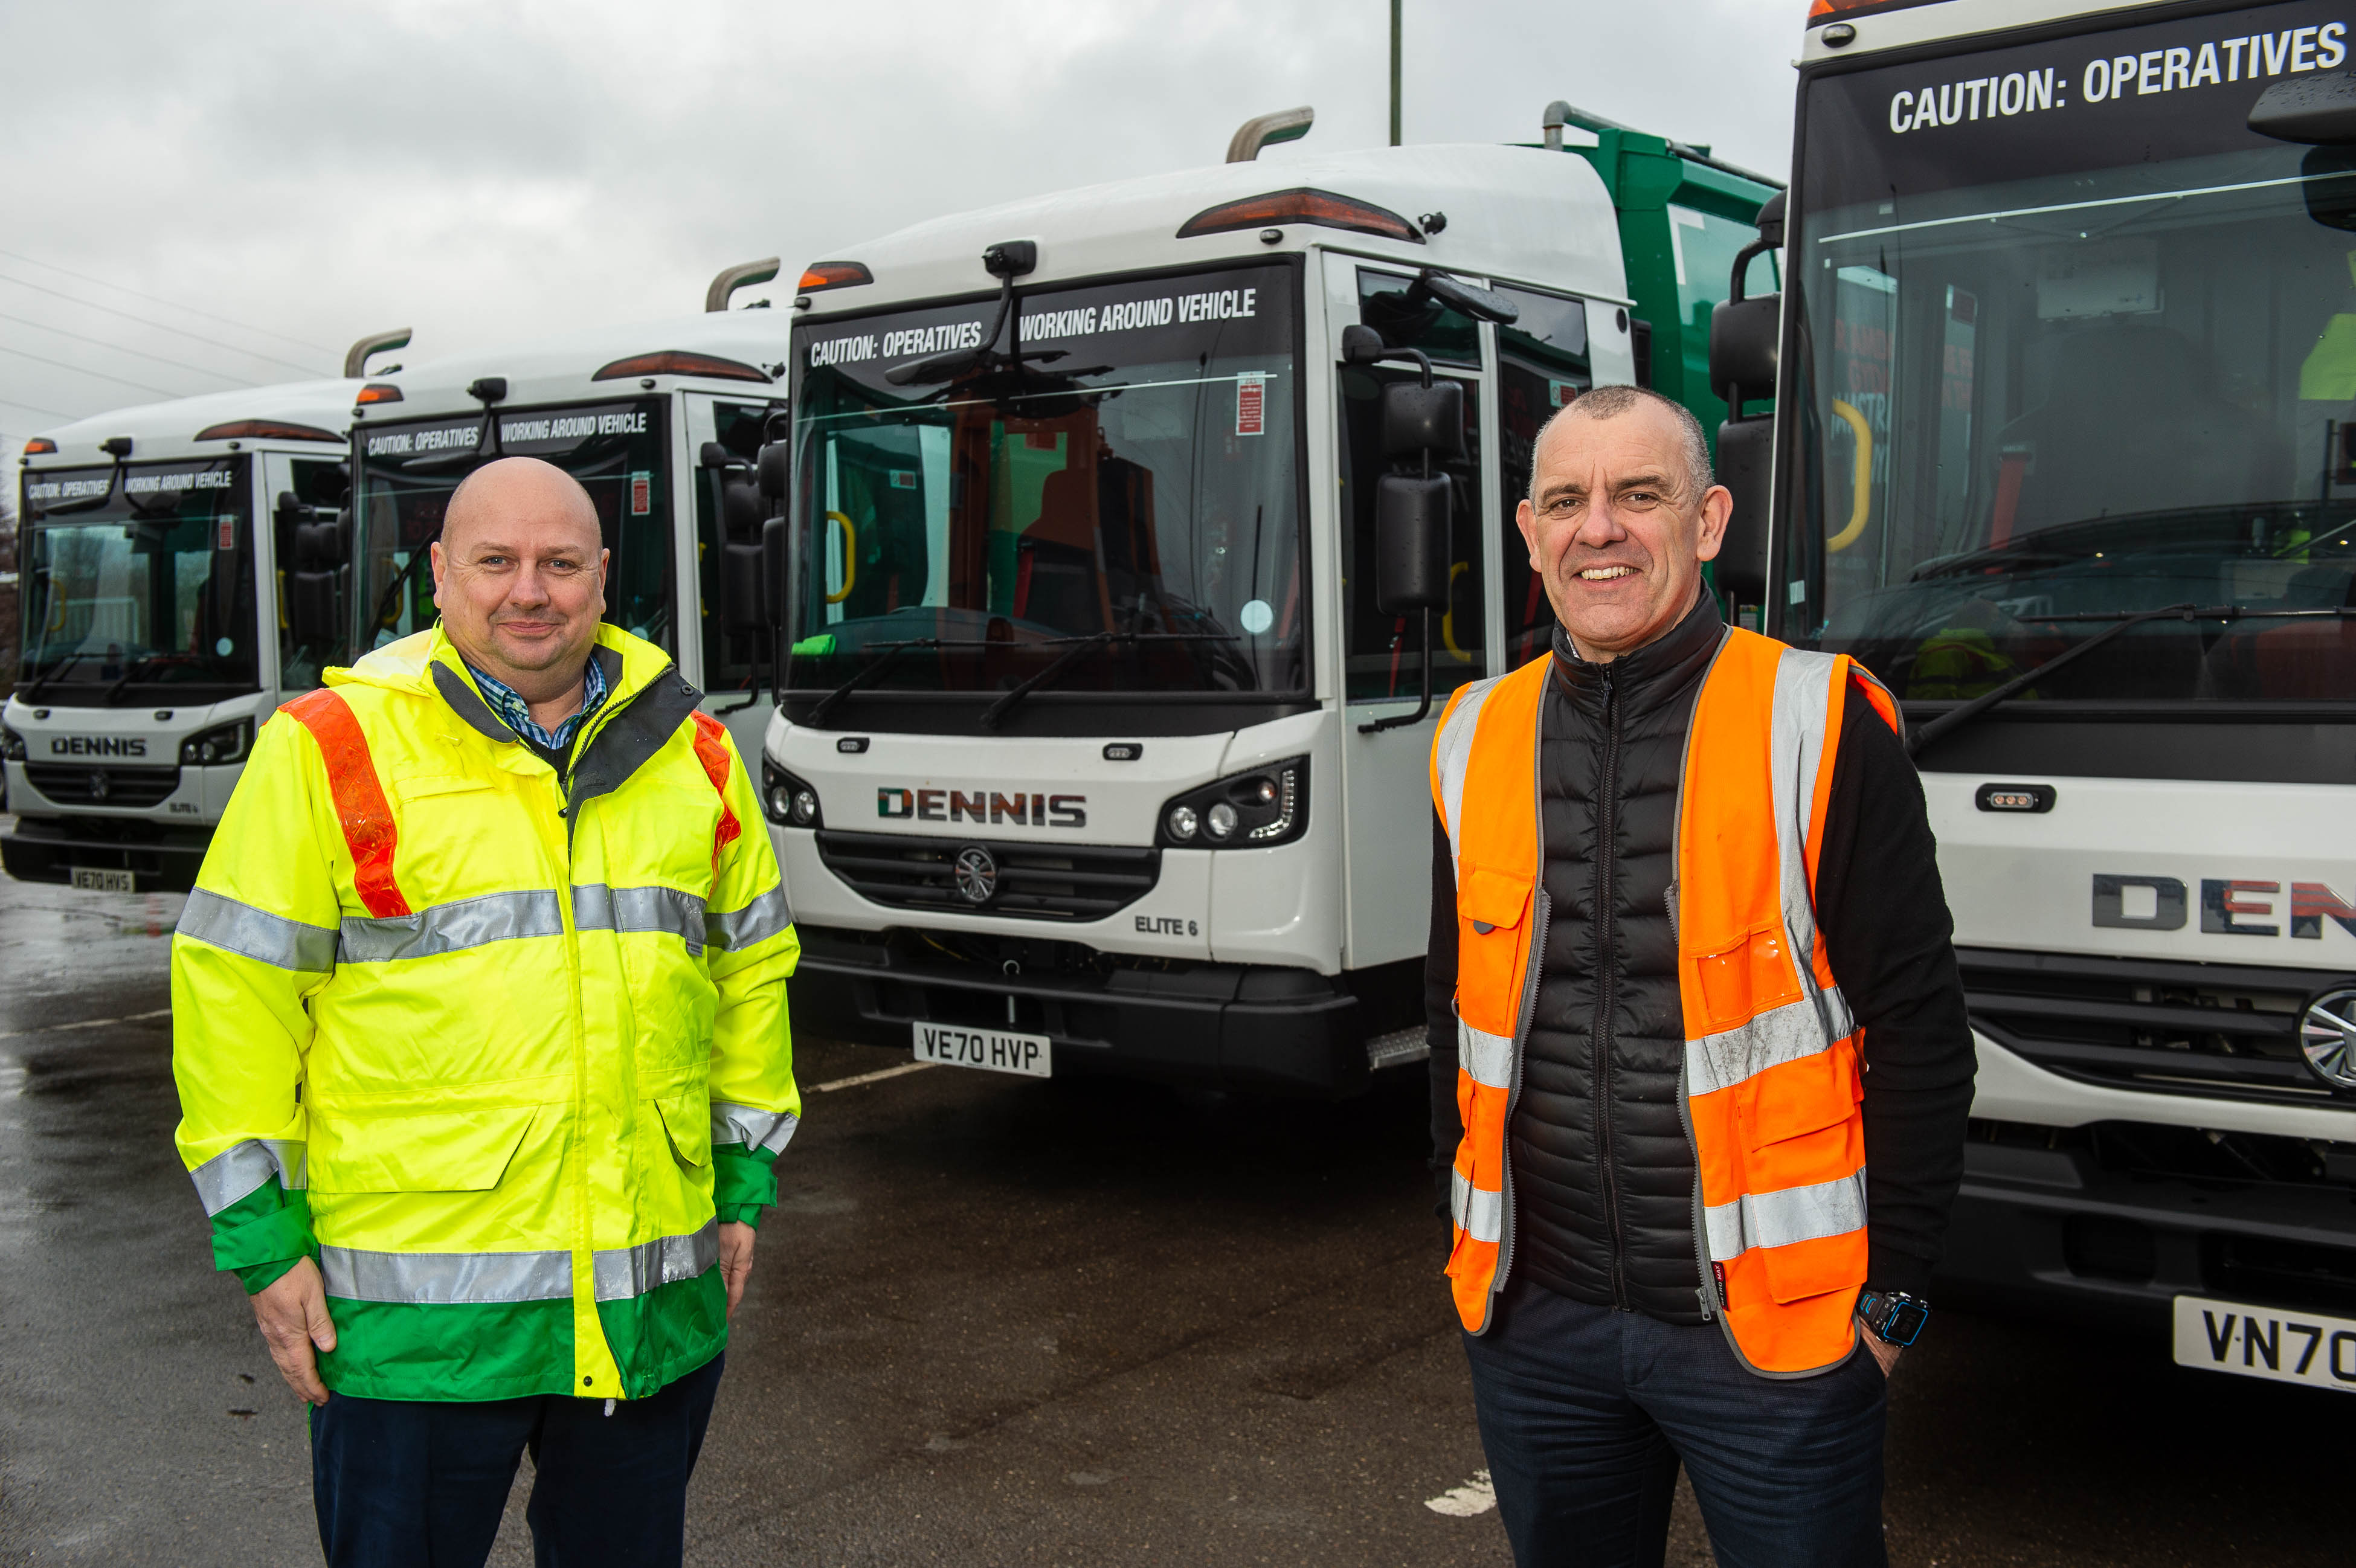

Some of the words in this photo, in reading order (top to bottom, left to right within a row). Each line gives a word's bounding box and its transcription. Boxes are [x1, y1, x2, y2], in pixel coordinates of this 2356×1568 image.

[1890, 67, 2067, 134] CAUTION:
[2083, 22, 2347, 103] OPERATIVES
[811, 334, 878, 368] CAUTION:
[883, 321, 982, 358] OPERATIVES
[1019, 307, 1096, 342] WORKING
[1099, 298, 1173, 332] AROUND
[1178, 288, 1256, 323] VEHICLE
[368, 434, 413, 457] CAUTION:
[415, 426, 479, 451] OPERATIVES
[501, 419, 550, 443] WORKING
[550, 416, 596, 439] AROUND
[598, 412, 647, 435] VEHICLE
[28, 483, 60, 500] CAUTION:
[62, 478, 110, 498] OPERATIVES
[124, 475, 161, 493] WORKING
[160, 472, 195, 492] AROUND
[195, 470, 233, 489] VEHICLE
[52, 736, 147, 756] DENNIS
[878, 786, 1087, 828] DENNIS
[1135, 915, 1183, 936] ELITE
[1188, 919, 1199, 937] 6
[2093, 873, 2356, 939] DEN
[924, 1027, 984, 1063] VE70
[991, 1036, 1039, 1070] HVP
[2202, 1309, 2356, 1382] VN70
